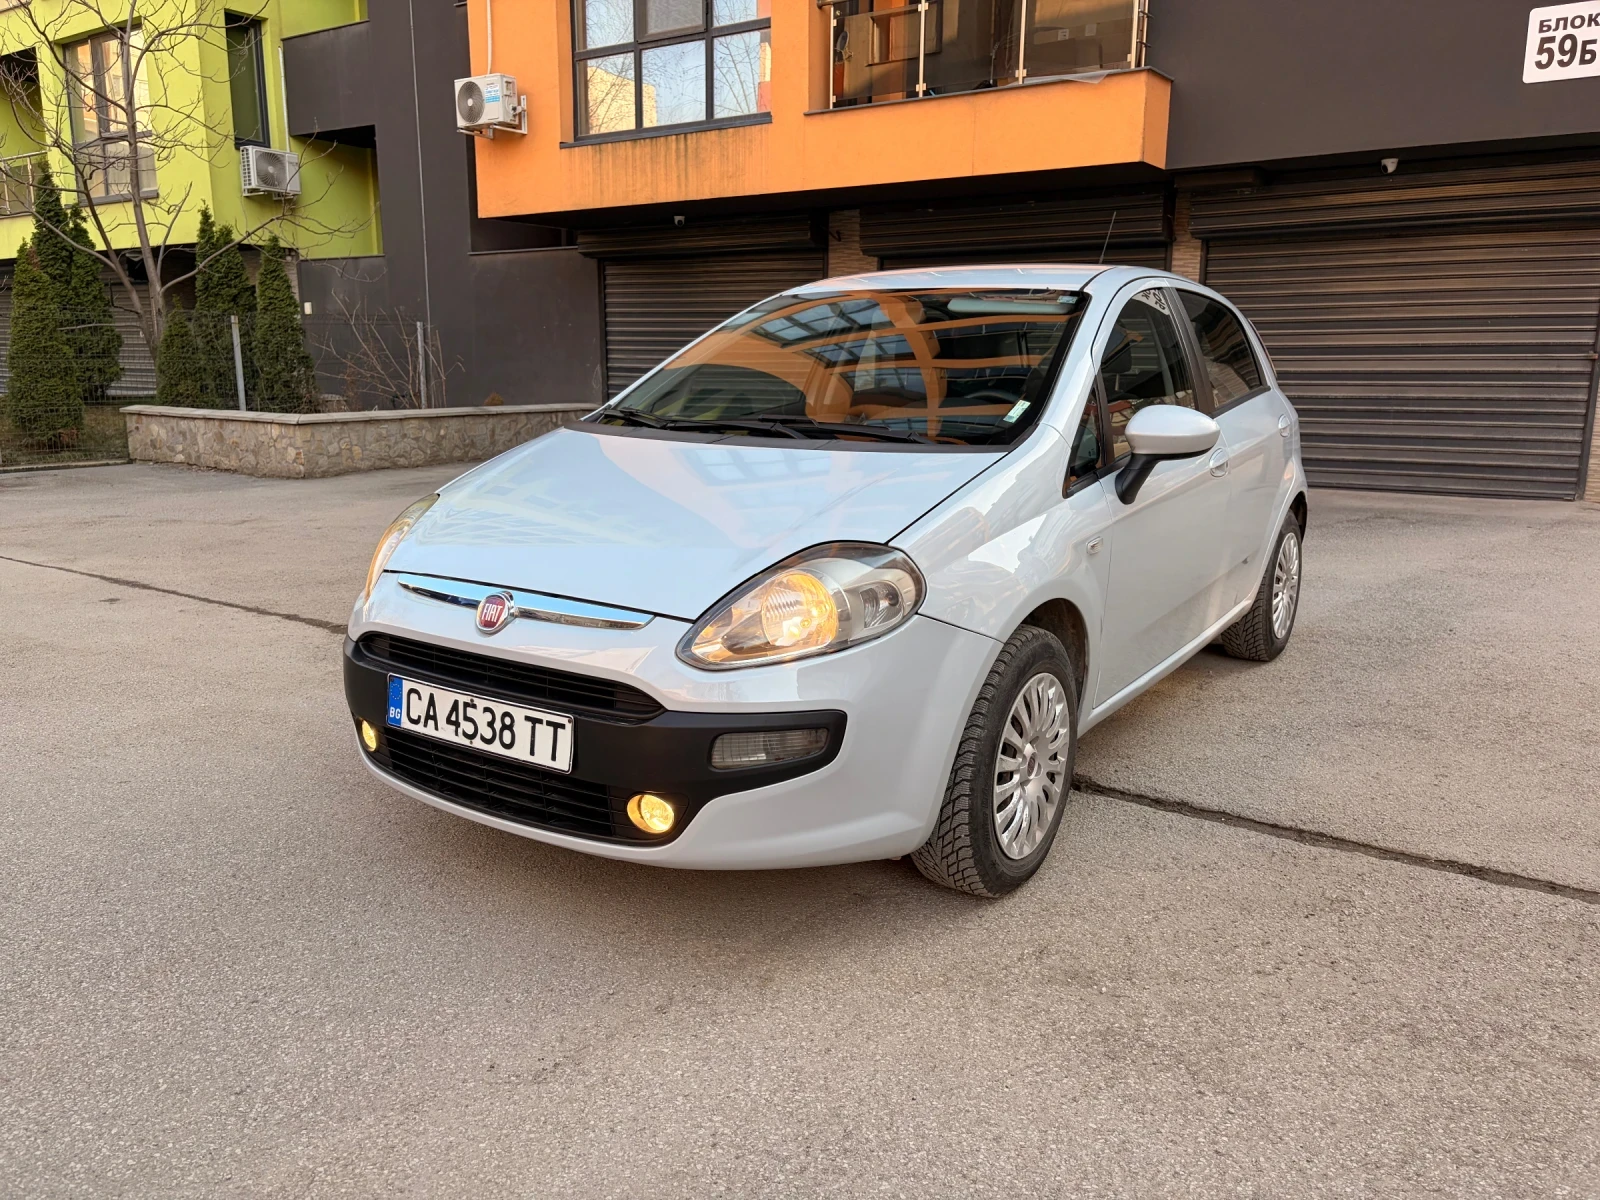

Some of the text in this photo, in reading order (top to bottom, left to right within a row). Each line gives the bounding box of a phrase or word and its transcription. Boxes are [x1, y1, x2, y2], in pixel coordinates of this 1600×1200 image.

[1538, 12, 1600, 34] БЛОК
[1534, 33, 1598, 70] 59Б
[481, 603, 503, 623] FIAT
[389, 706, 401, 719] BG
[445, 699, 516, 750] 4538
[524, 715, 566, 762] TT
